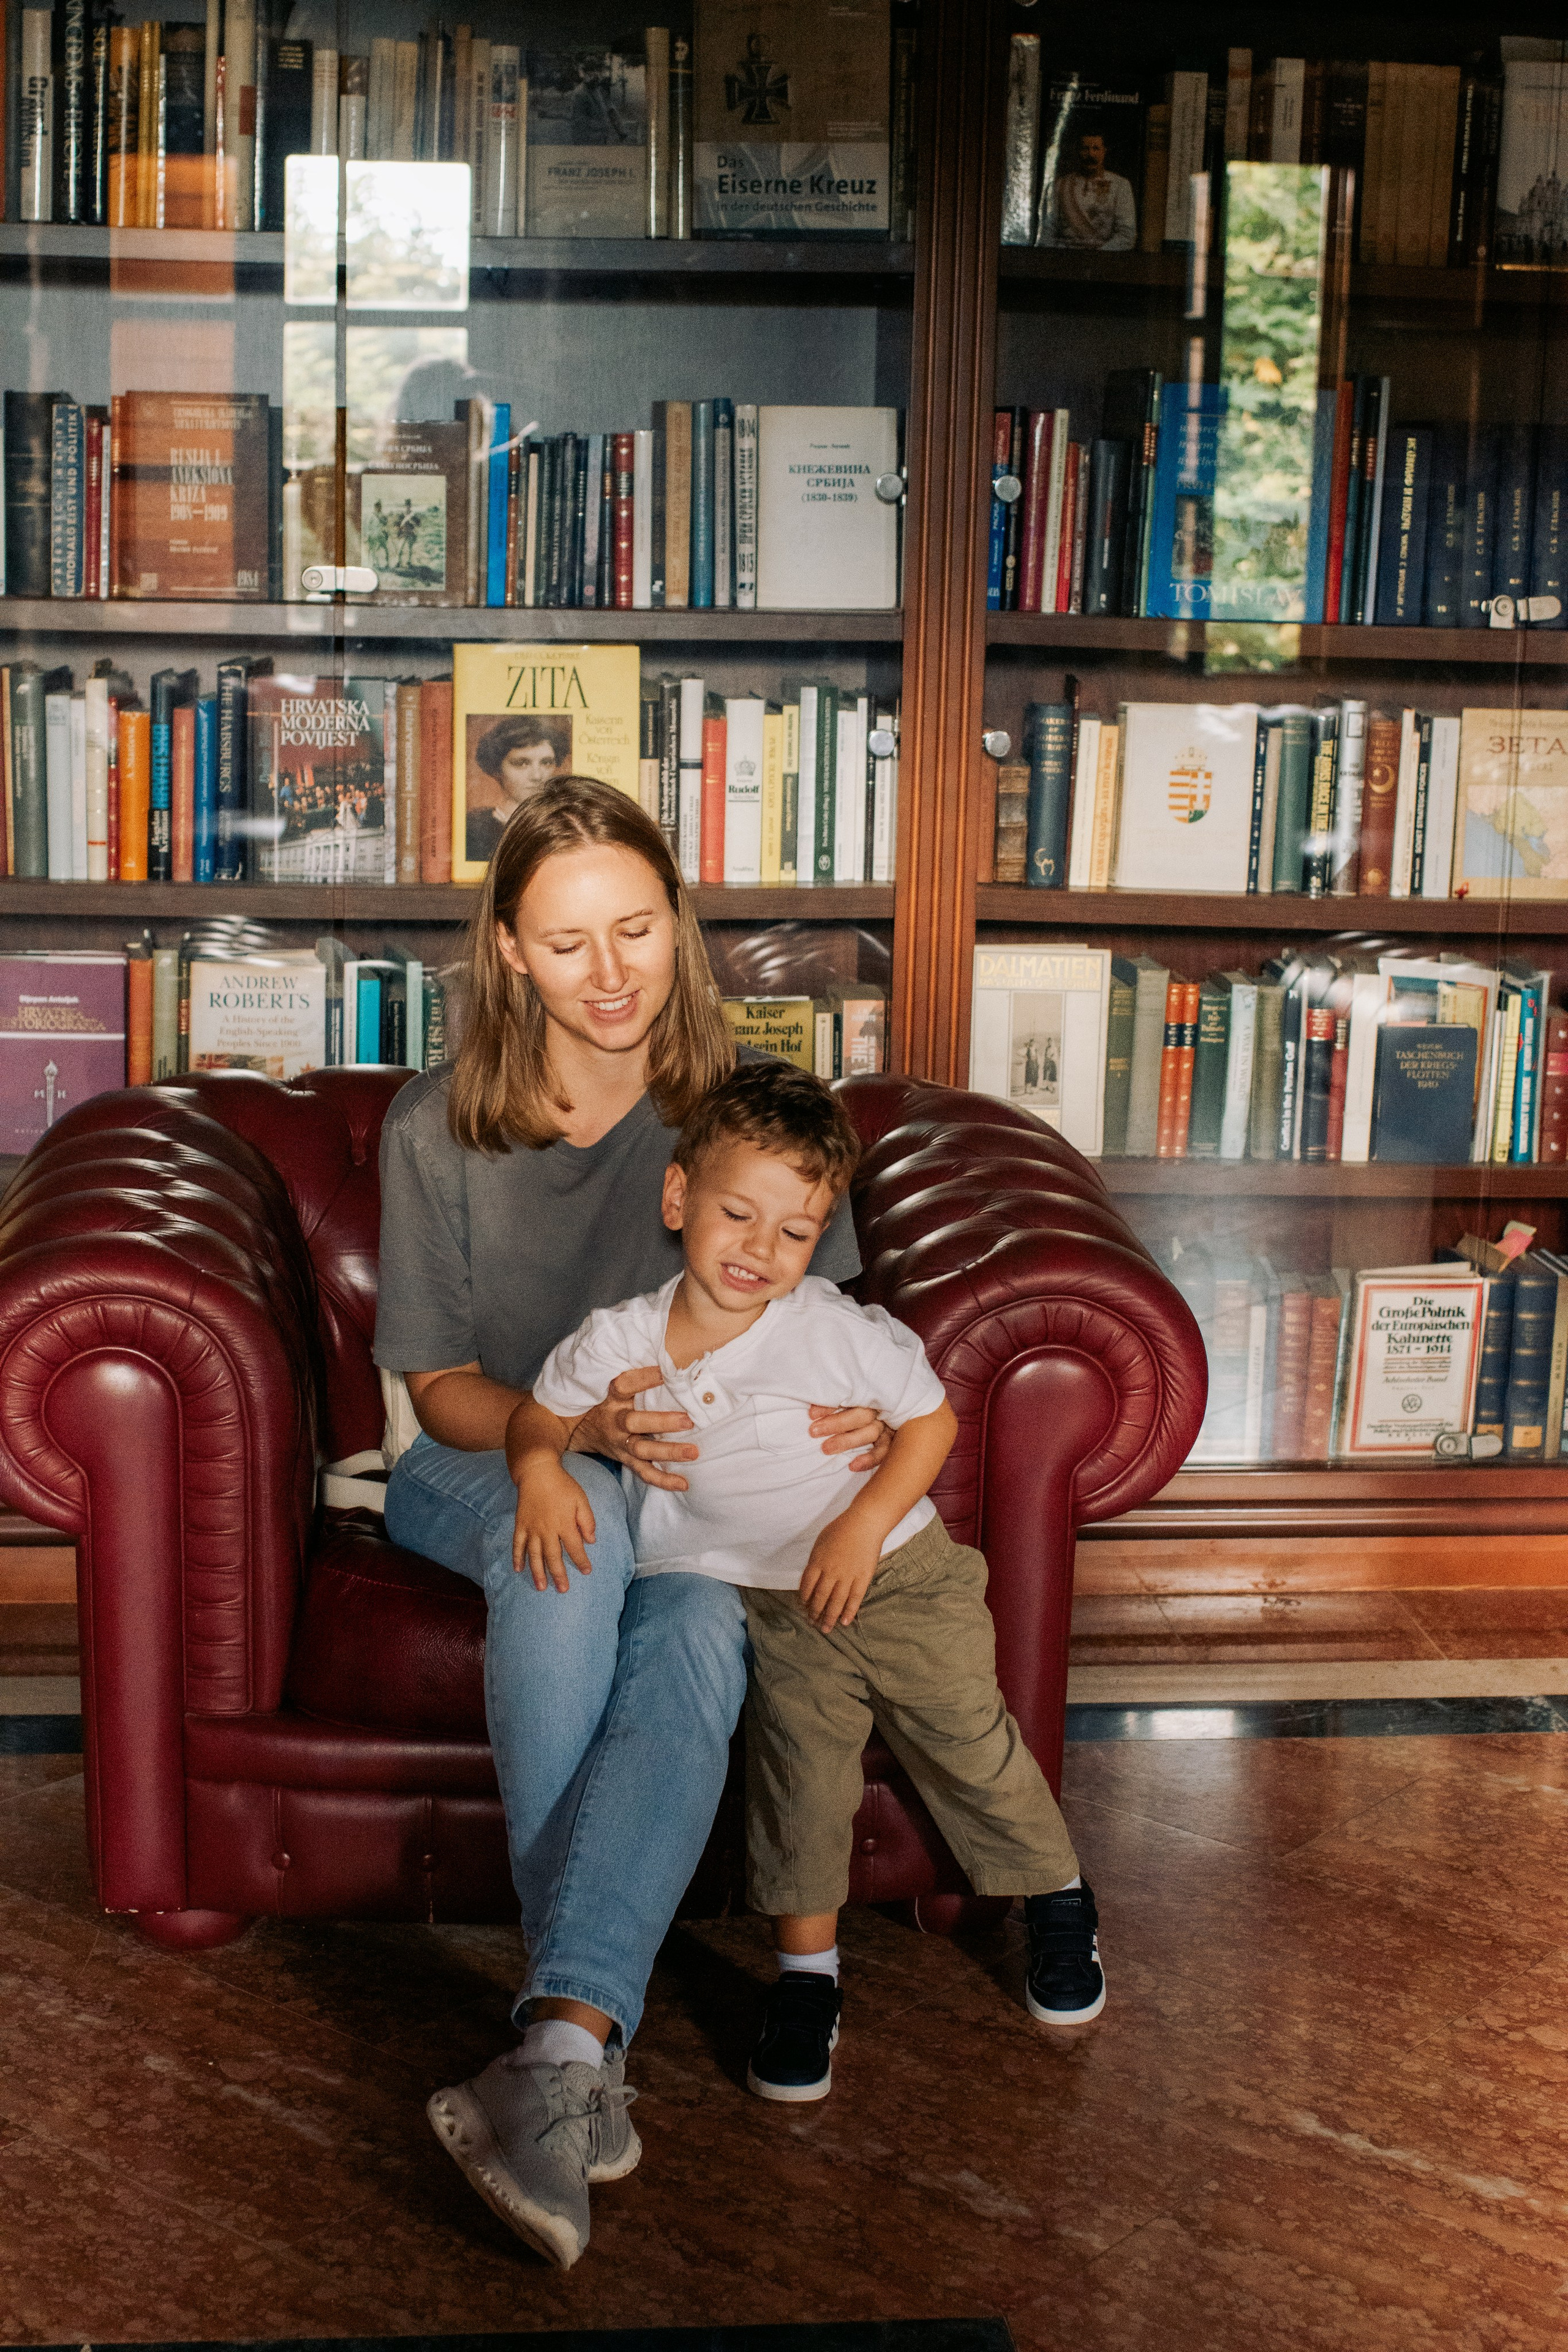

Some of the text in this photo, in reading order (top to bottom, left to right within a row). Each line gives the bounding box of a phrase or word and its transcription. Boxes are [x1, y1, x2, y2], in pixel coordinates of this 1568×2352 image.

[717, 155, 744, 168] Das
[548, 167, 581, 178] FRANZ
[586, 167, 626, 178] JOSEPH
[717, 174, 877, 195] Eiserne Kreuz
[753, 202, 812, 212] deutschen
[815, 202, 877, 212] Geschichte
[67, 413, 77, 462] POLITIK
[788, 464, 871, 474] КНЕЖЕВИНА
[67, 468, 77, 494] UND
[807, 478, 855, 489] СРБИЈА
[1169, 582, 1303, 608] TOMISLAV
[506, 665, 589, 709] ZITA
[280, 699, 369, 716] HRVATSKA
[281, 715, 370, 731] MODERNA
[585, 714, 624, 725] Kaiserin
[219, 677, 233, 793] THE HABSBURGS
[281, 730, 360, 749] POVIJEST
[1487, 736, 1568, 756] ЗЕТА
[728, 784, 760, 794] Rudolf
[1415, 791, 1425, 828] STRATEGIC
[979, 954, 1101, 979] DALMATIEN
[219, 976, 298, 990] ANDREW
[209, 992, 311, 1009] ROBERTS
[18, 1006, 84, 1020] HRVATSKA
[232, 1016, 269, 1025] History
[281, 1015, 295, 1023] the
[746, 1007, 785, 1019] Kaiser
[734, 1022, 804, 1038] ranz Joseph
[780, 1039, 802, 1052] Hof
[1285, 1041, 1295, 1061] Gulf
[1284, 1062, 1293, 1093] Persian
[1283, 1094, 1292, 1109] the
[1281, 1118, 1290, 1151] Conflict
[1413, 1296, 1434, 1306] Die
[1379, 1306, 1466, 1319] Große Politik
[1371, 1321, 1470, 1333] der Europäischen
[1387, 1333, 1453, 1344] Kabinette
[1387, 1345, 1413, 1355] 1871
[1426, 1344, 1453, 1354] 1914
